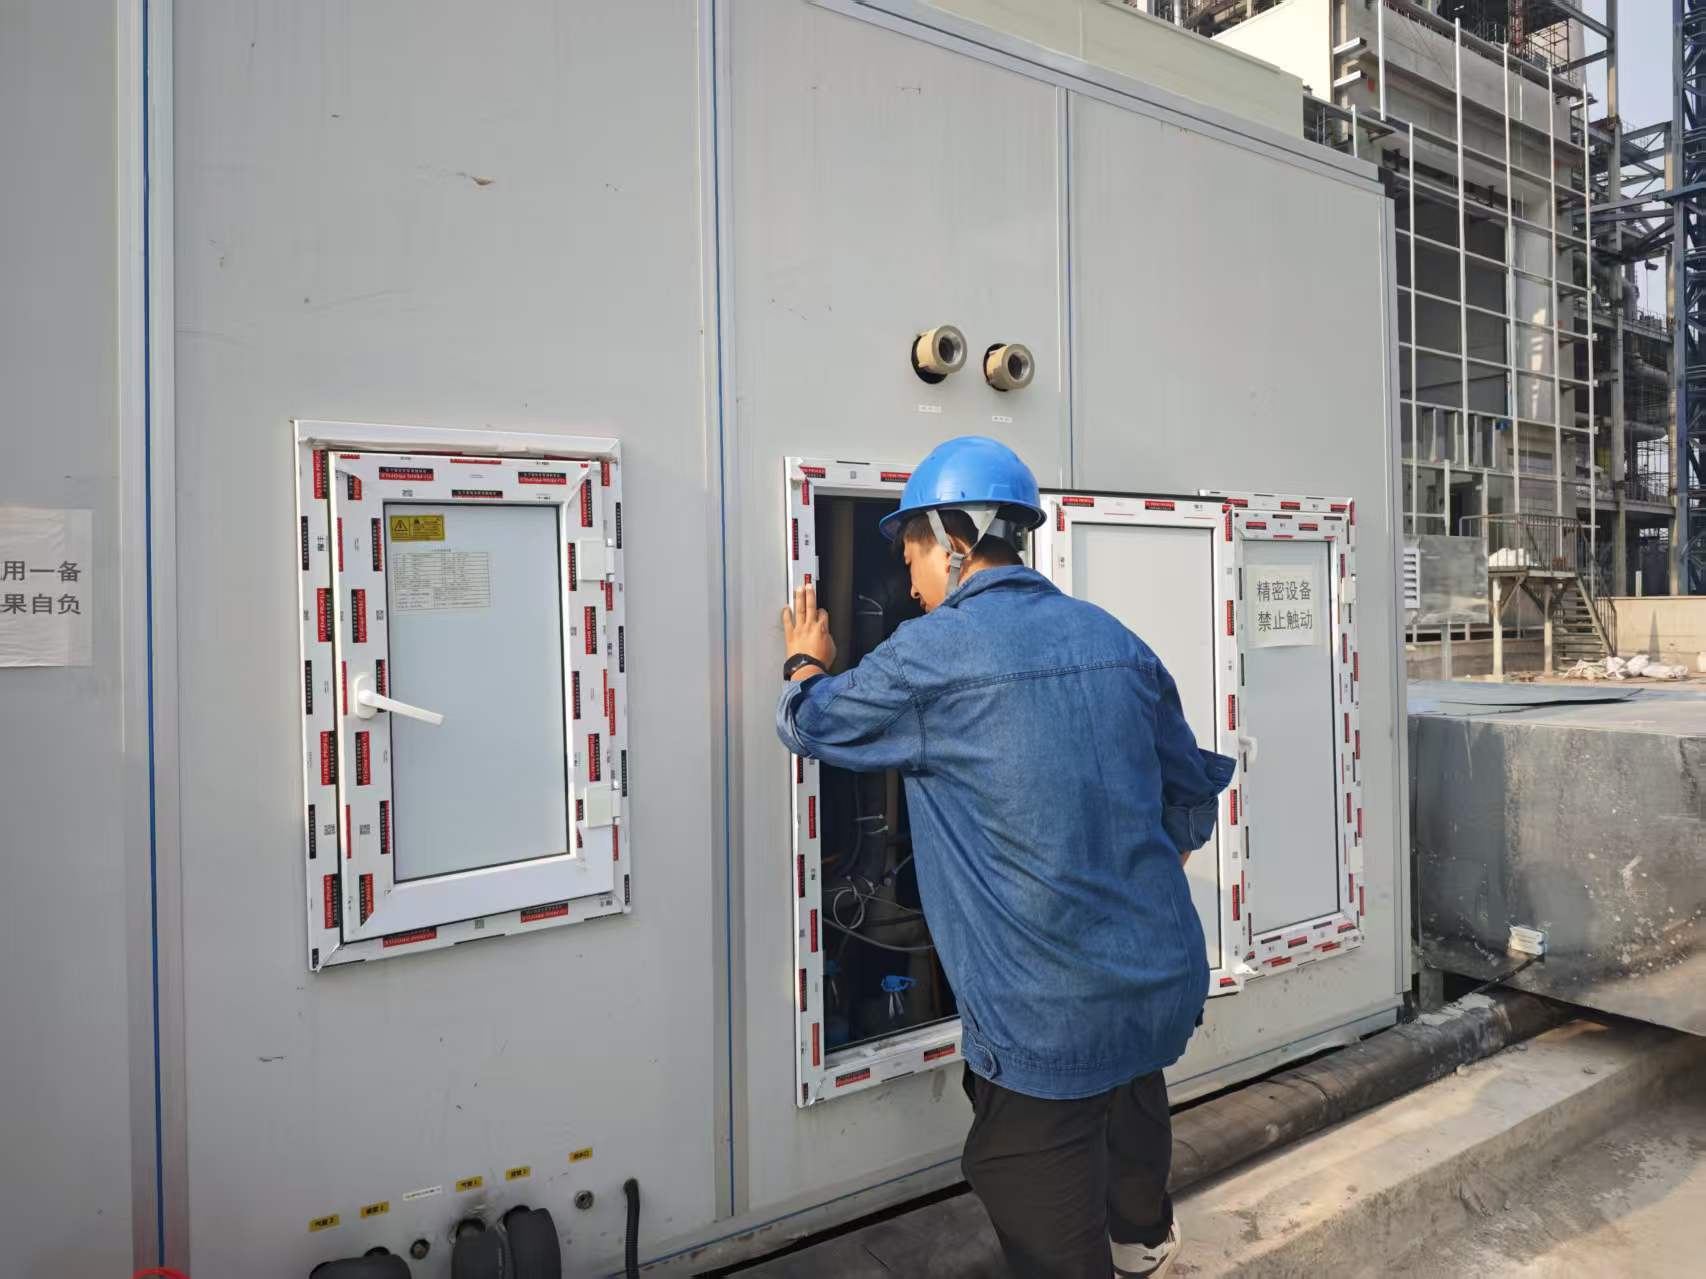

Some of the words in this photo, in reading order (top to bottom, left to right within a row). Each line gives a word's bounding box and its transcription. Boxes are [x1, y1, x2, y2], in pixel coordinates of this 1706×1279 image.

[2, 560, 82, 582] 用一备
[1256, 580, 1311, 602] 精密设备
[0, 593, 82, 614] 果自负
[1257, 609, 1312, 632] 禁止触动
